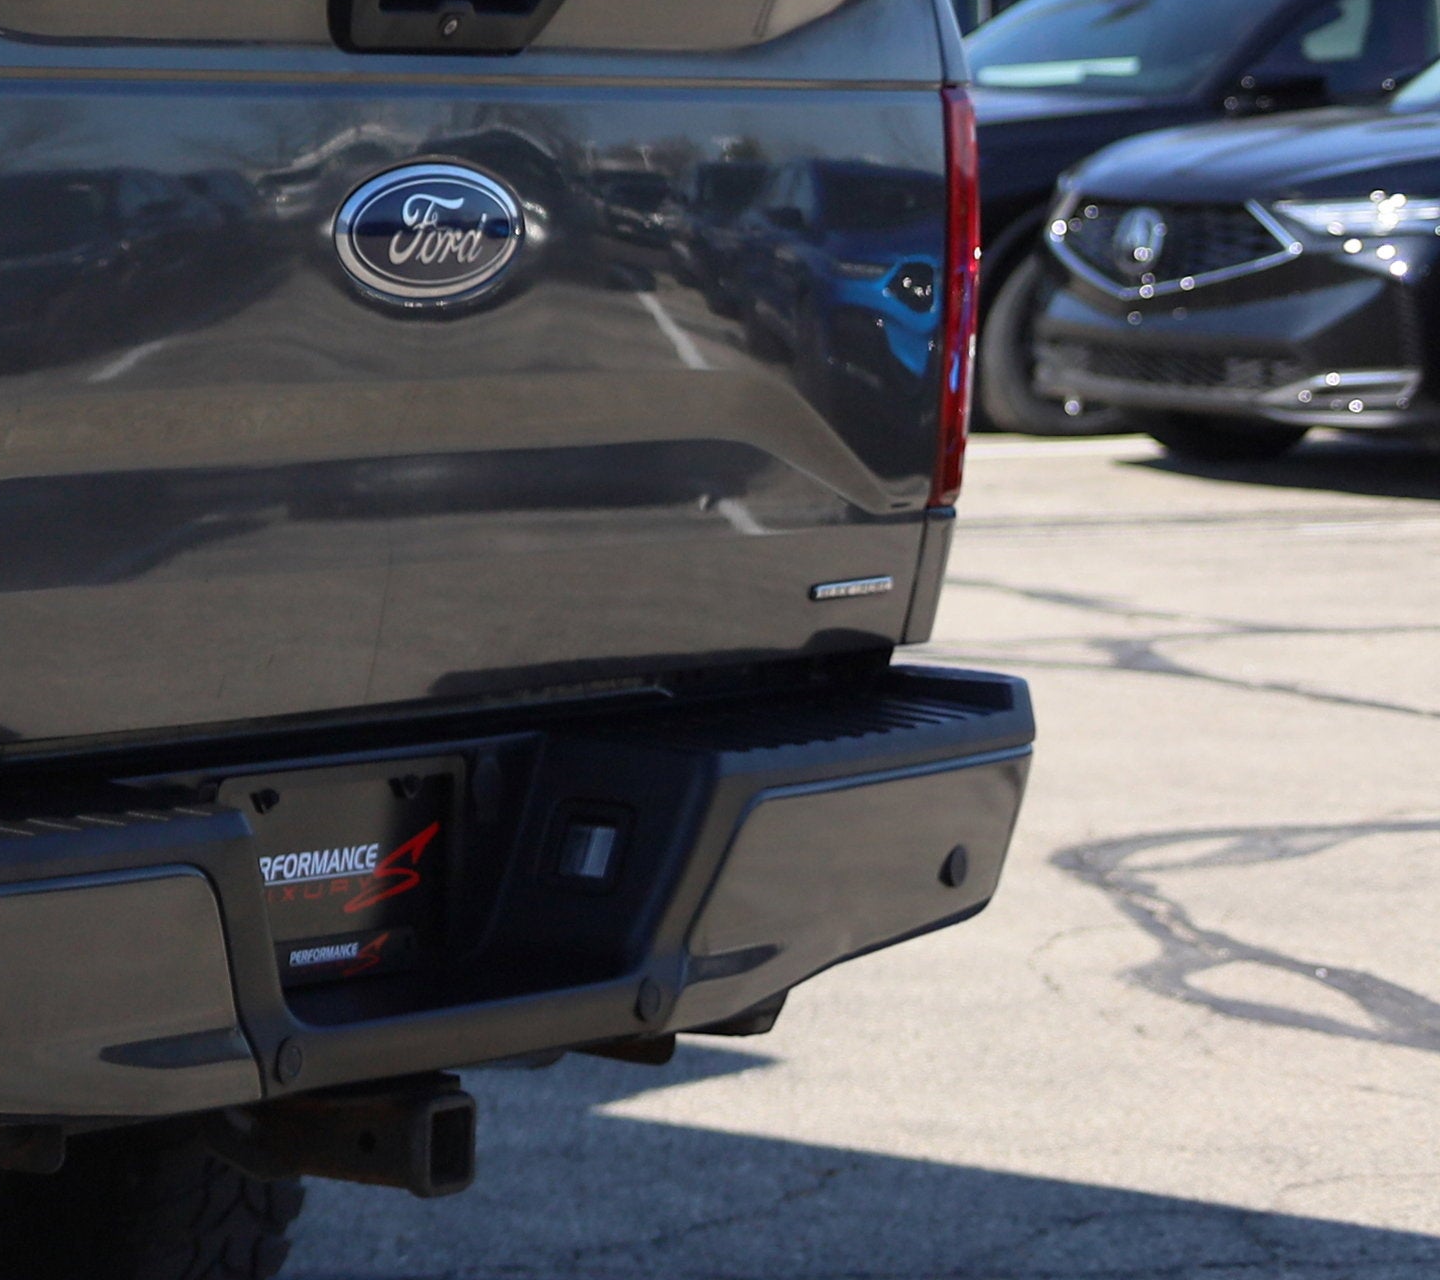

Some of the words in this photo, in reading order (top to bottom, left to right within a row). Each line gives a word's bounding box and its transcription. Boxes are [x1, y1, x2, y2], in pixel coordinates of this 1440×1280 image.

[389, 193, 488, 265] Ford
[259, 842, 379, 882] RFORMANCE
[289, 941, 360, 967] PERFORMANCE
